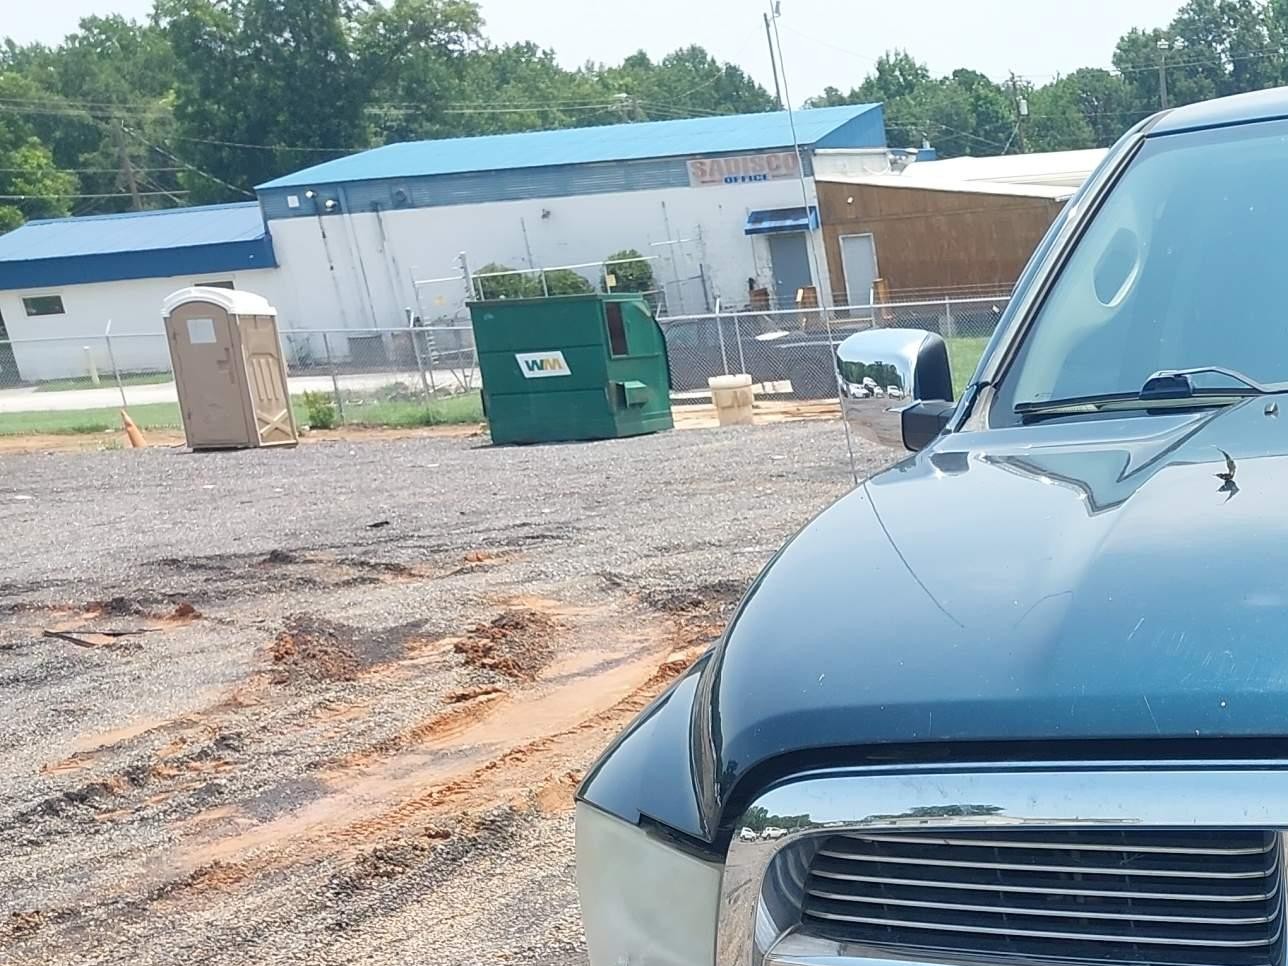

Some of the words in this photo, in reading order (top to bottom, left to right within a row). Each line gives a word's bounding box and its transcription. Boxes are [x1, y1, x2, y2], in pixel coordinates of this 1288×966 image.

[690, 152, 799, 178] SADISCO
[723, 173, 769, 184] OFFICE
[524, 358, 563, 372] WM
